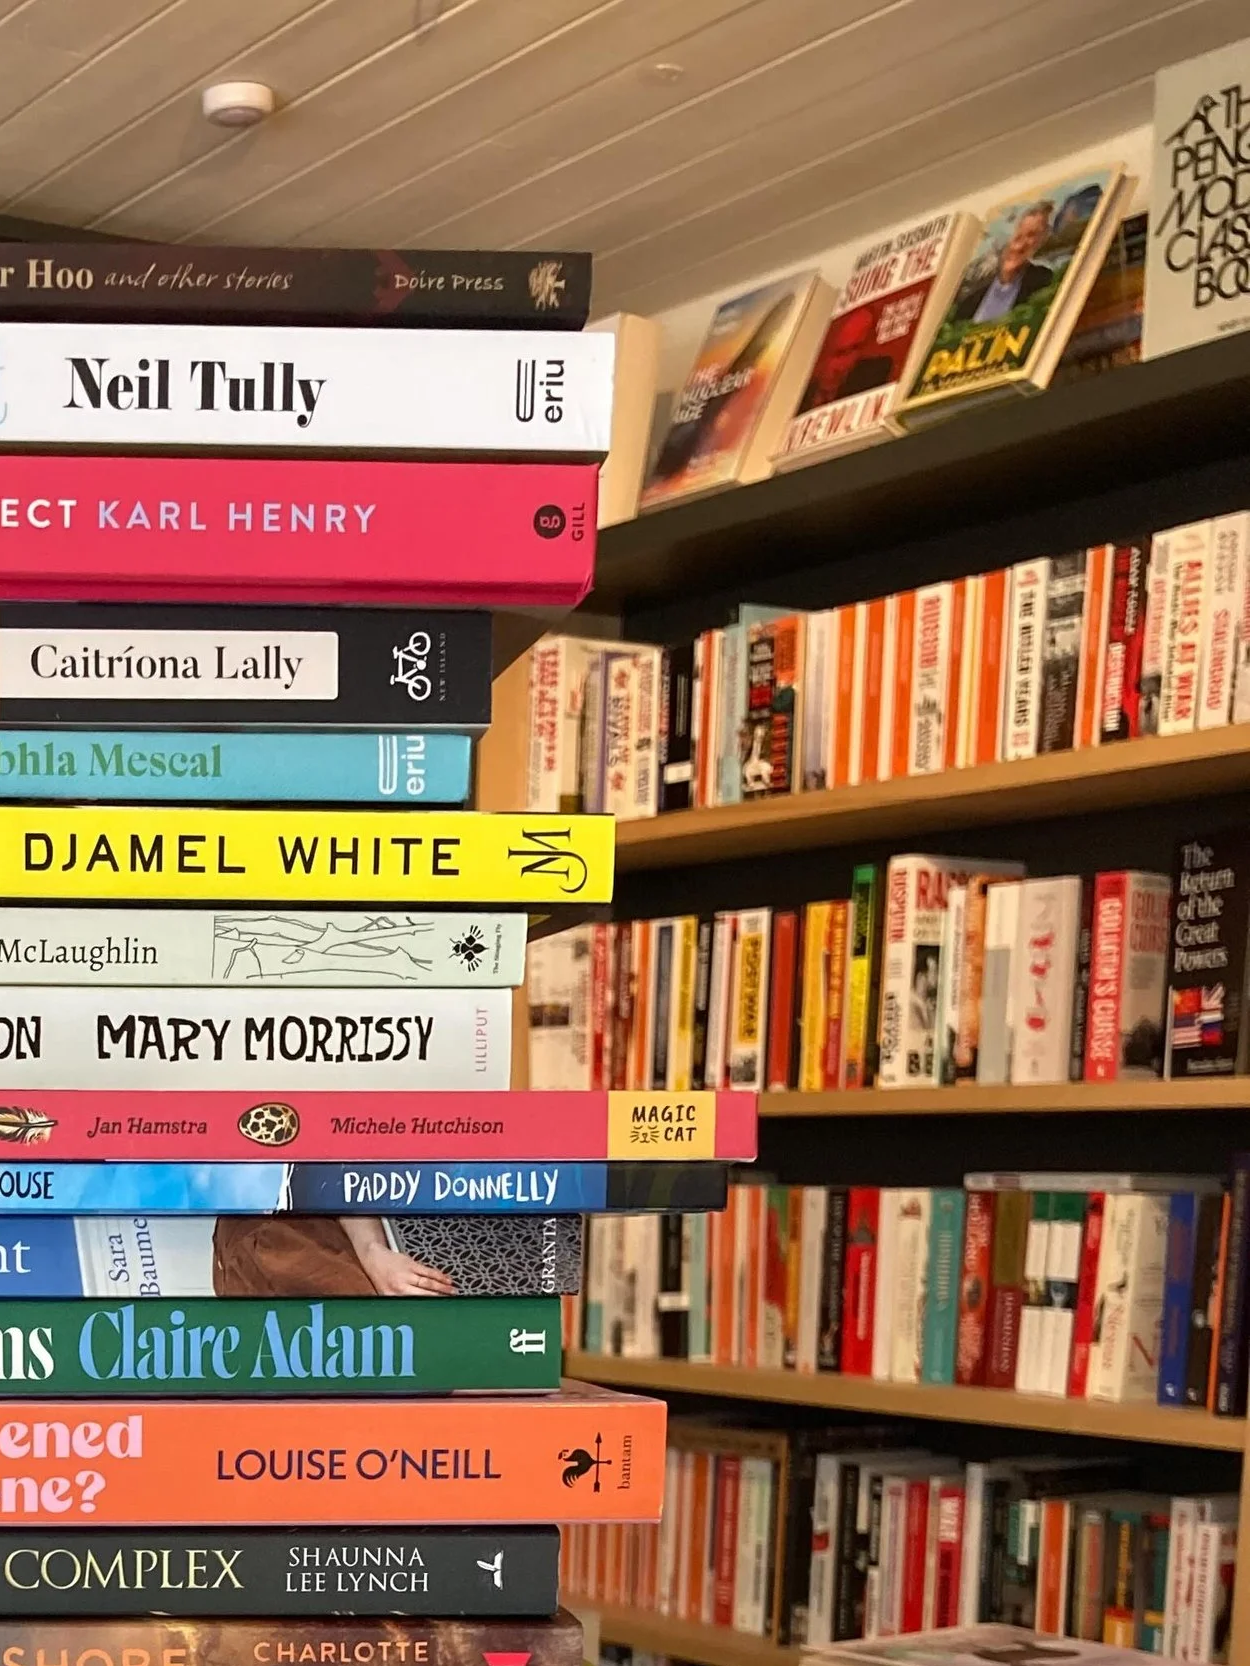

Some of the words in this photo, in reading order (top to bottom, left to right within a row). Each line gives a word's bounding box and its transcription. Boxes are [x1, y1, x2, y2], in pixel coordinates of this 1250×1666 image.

[26, 260, 93, 290] Hoo
[104, 263, 156, 289] and
[157, 260, 217, 290] other
[225, 264, 292, 291] stories
[395, 273, 445, 291] Doire
[452, 275, 504, 291] Press
[63, 358, 172, 410] Neil
[191, 362, 326, 427] Tully
[541, 359, 564, 424] eriu
[31, 642, 201, 681] Caitríona
[214, 645, 303, 690] Lally
[1180, 868, 1235, 895] Return
[1177, 896, 1196, 920] of
[1197, 894, 1223, 917] the
[1175, 922, 1220, 946] Great
[1174, 948, 1228, 972] Powers
[87, 1116, 123, 1135] Jan
[127, 1116, 207, 1135] Hamstra
[330, 1115, 406, 1135] Michele
[410, 1115, 504, 1135] Hutchison
[632, 1104, 697, 1123] MAGIC
[664, 1126, 697, 1143] CAT
[109, 1232, 130, 1284] Sara
[139, 1216, 162, 1297] Baume
[543, 1218, 558, 1294] GRANTA
[217, 1449, 348, 1481] LOUISE
[355, 1449, 502, 1481] O'NEILL
[618, 1434, 632, 1490] bantam
[253, 1641, 429, 1663] CHARLOTTE
